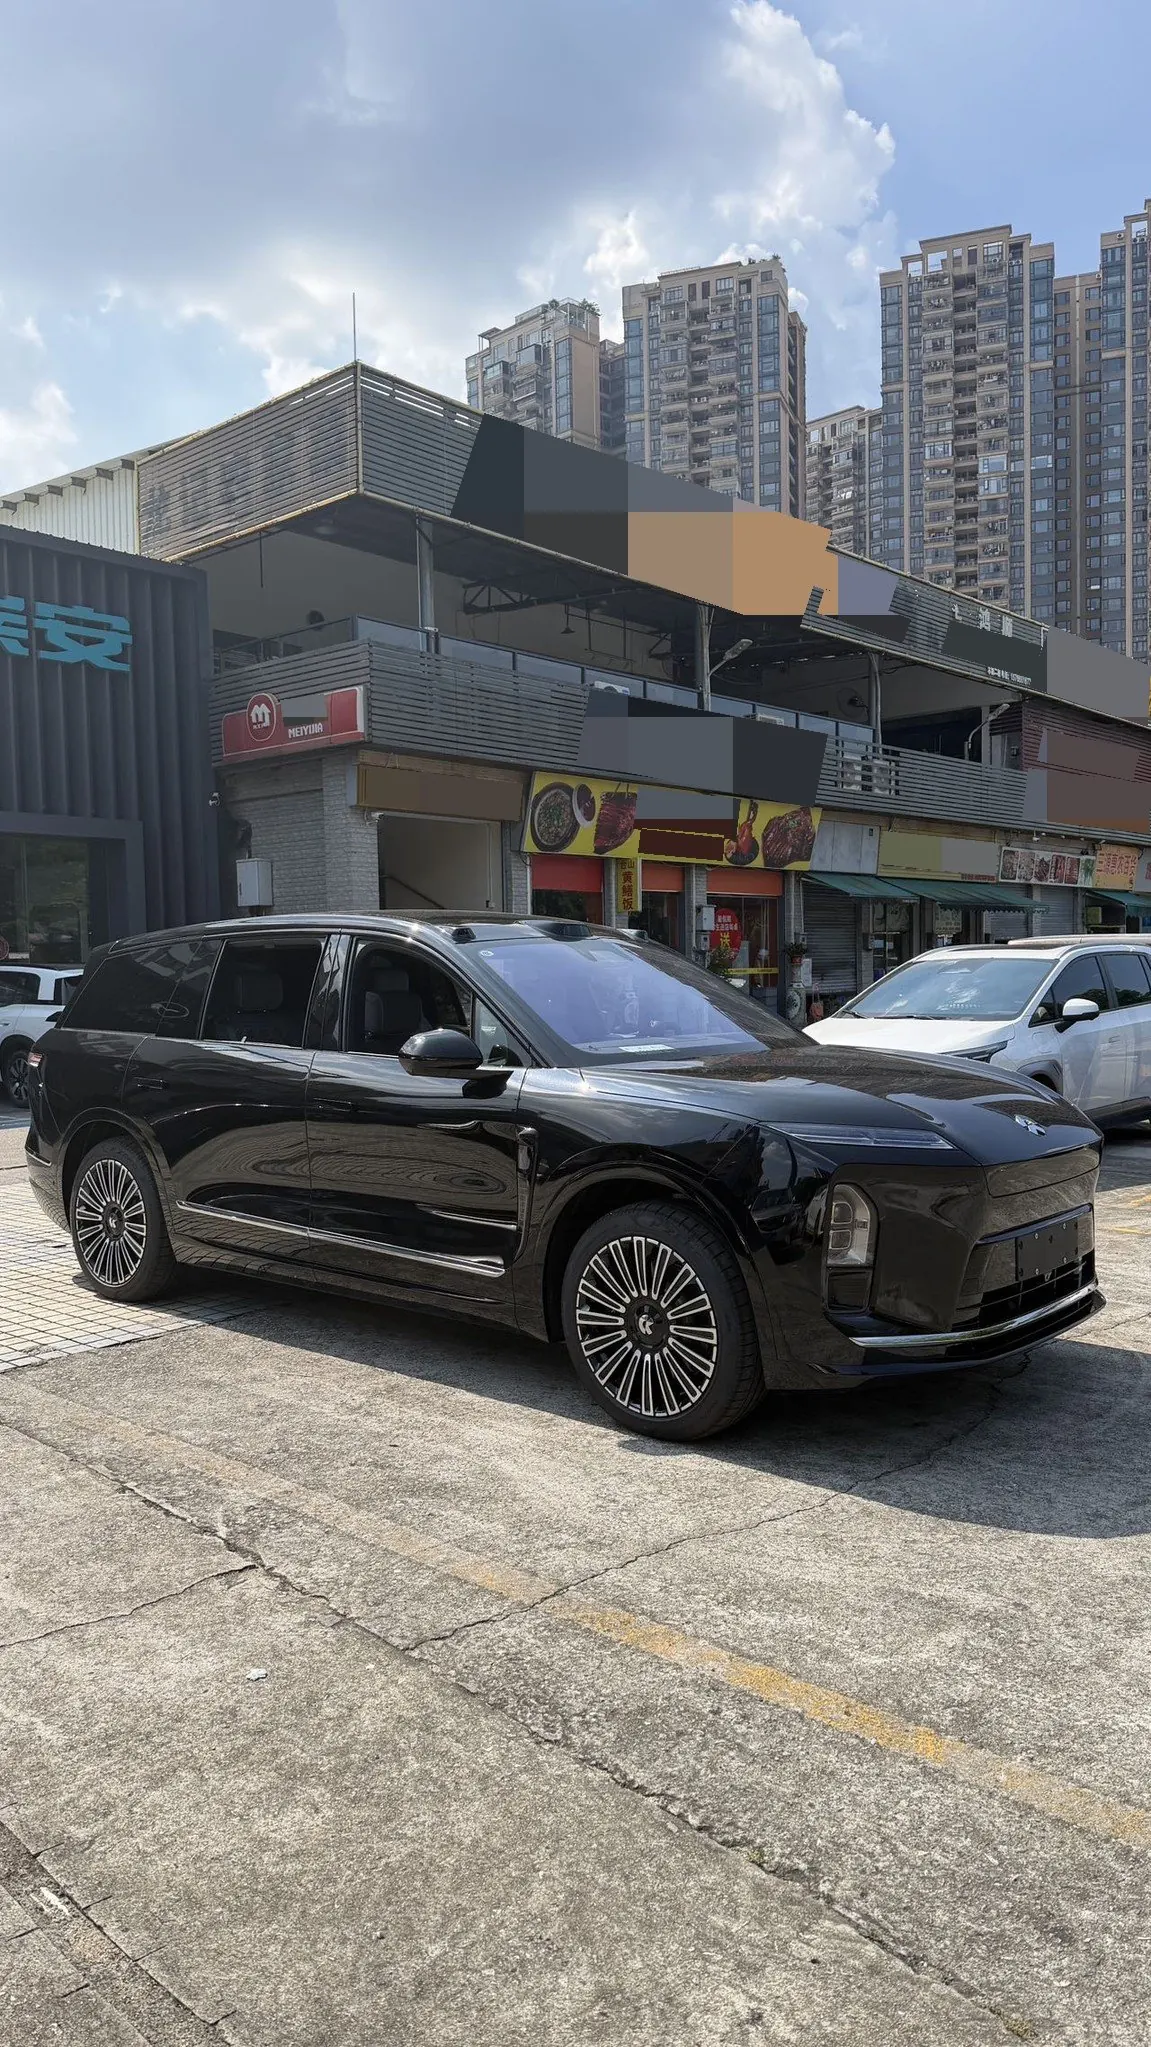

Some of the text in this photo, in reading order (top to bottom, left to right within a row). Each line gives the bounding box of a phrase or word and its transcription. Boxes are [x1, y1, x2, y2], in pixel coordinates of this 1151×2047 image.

[288, 722, 323, 739] MEIYIJIA
[622, 872, 634, 910] 黄鳝饭
